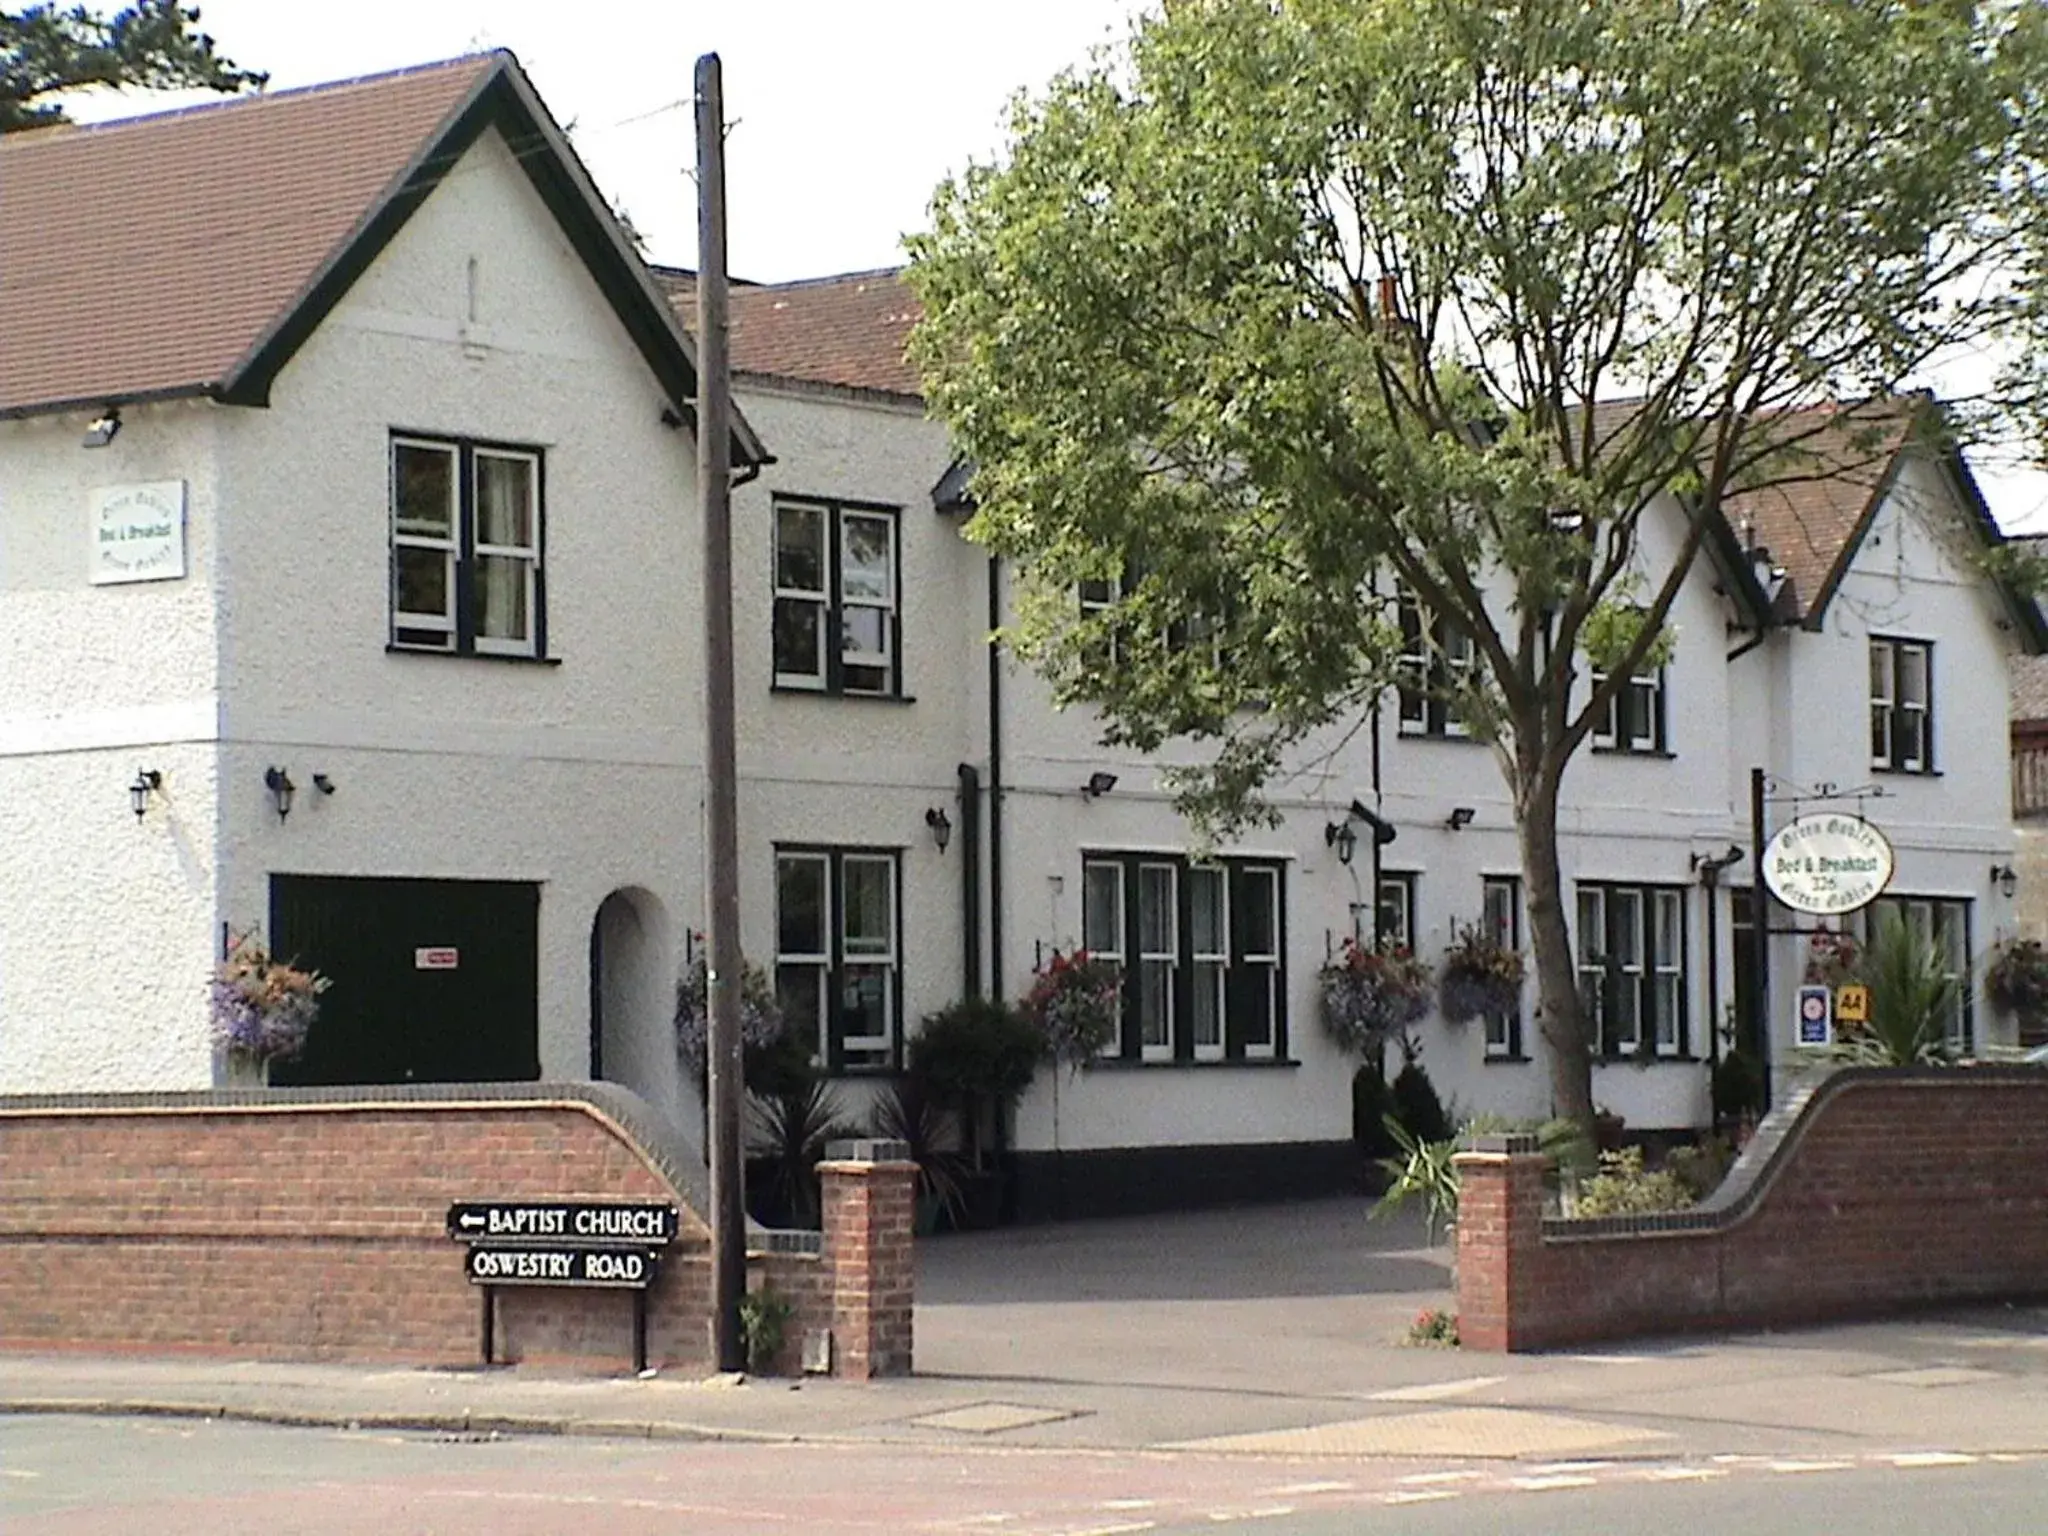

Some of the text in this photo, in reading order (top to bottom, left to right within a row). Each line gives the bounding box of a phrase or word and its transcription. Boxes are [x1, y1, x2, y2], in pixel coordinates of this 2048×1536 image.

[1776, 856, 1877, 873] Bed & Breakfast
[1840, 993, 1862, 1009] AA
[488, 1208, 664, 1236] BAPTIST CHURCH
[472, 1251, 643, 1279] OSWESTRY ROAD
